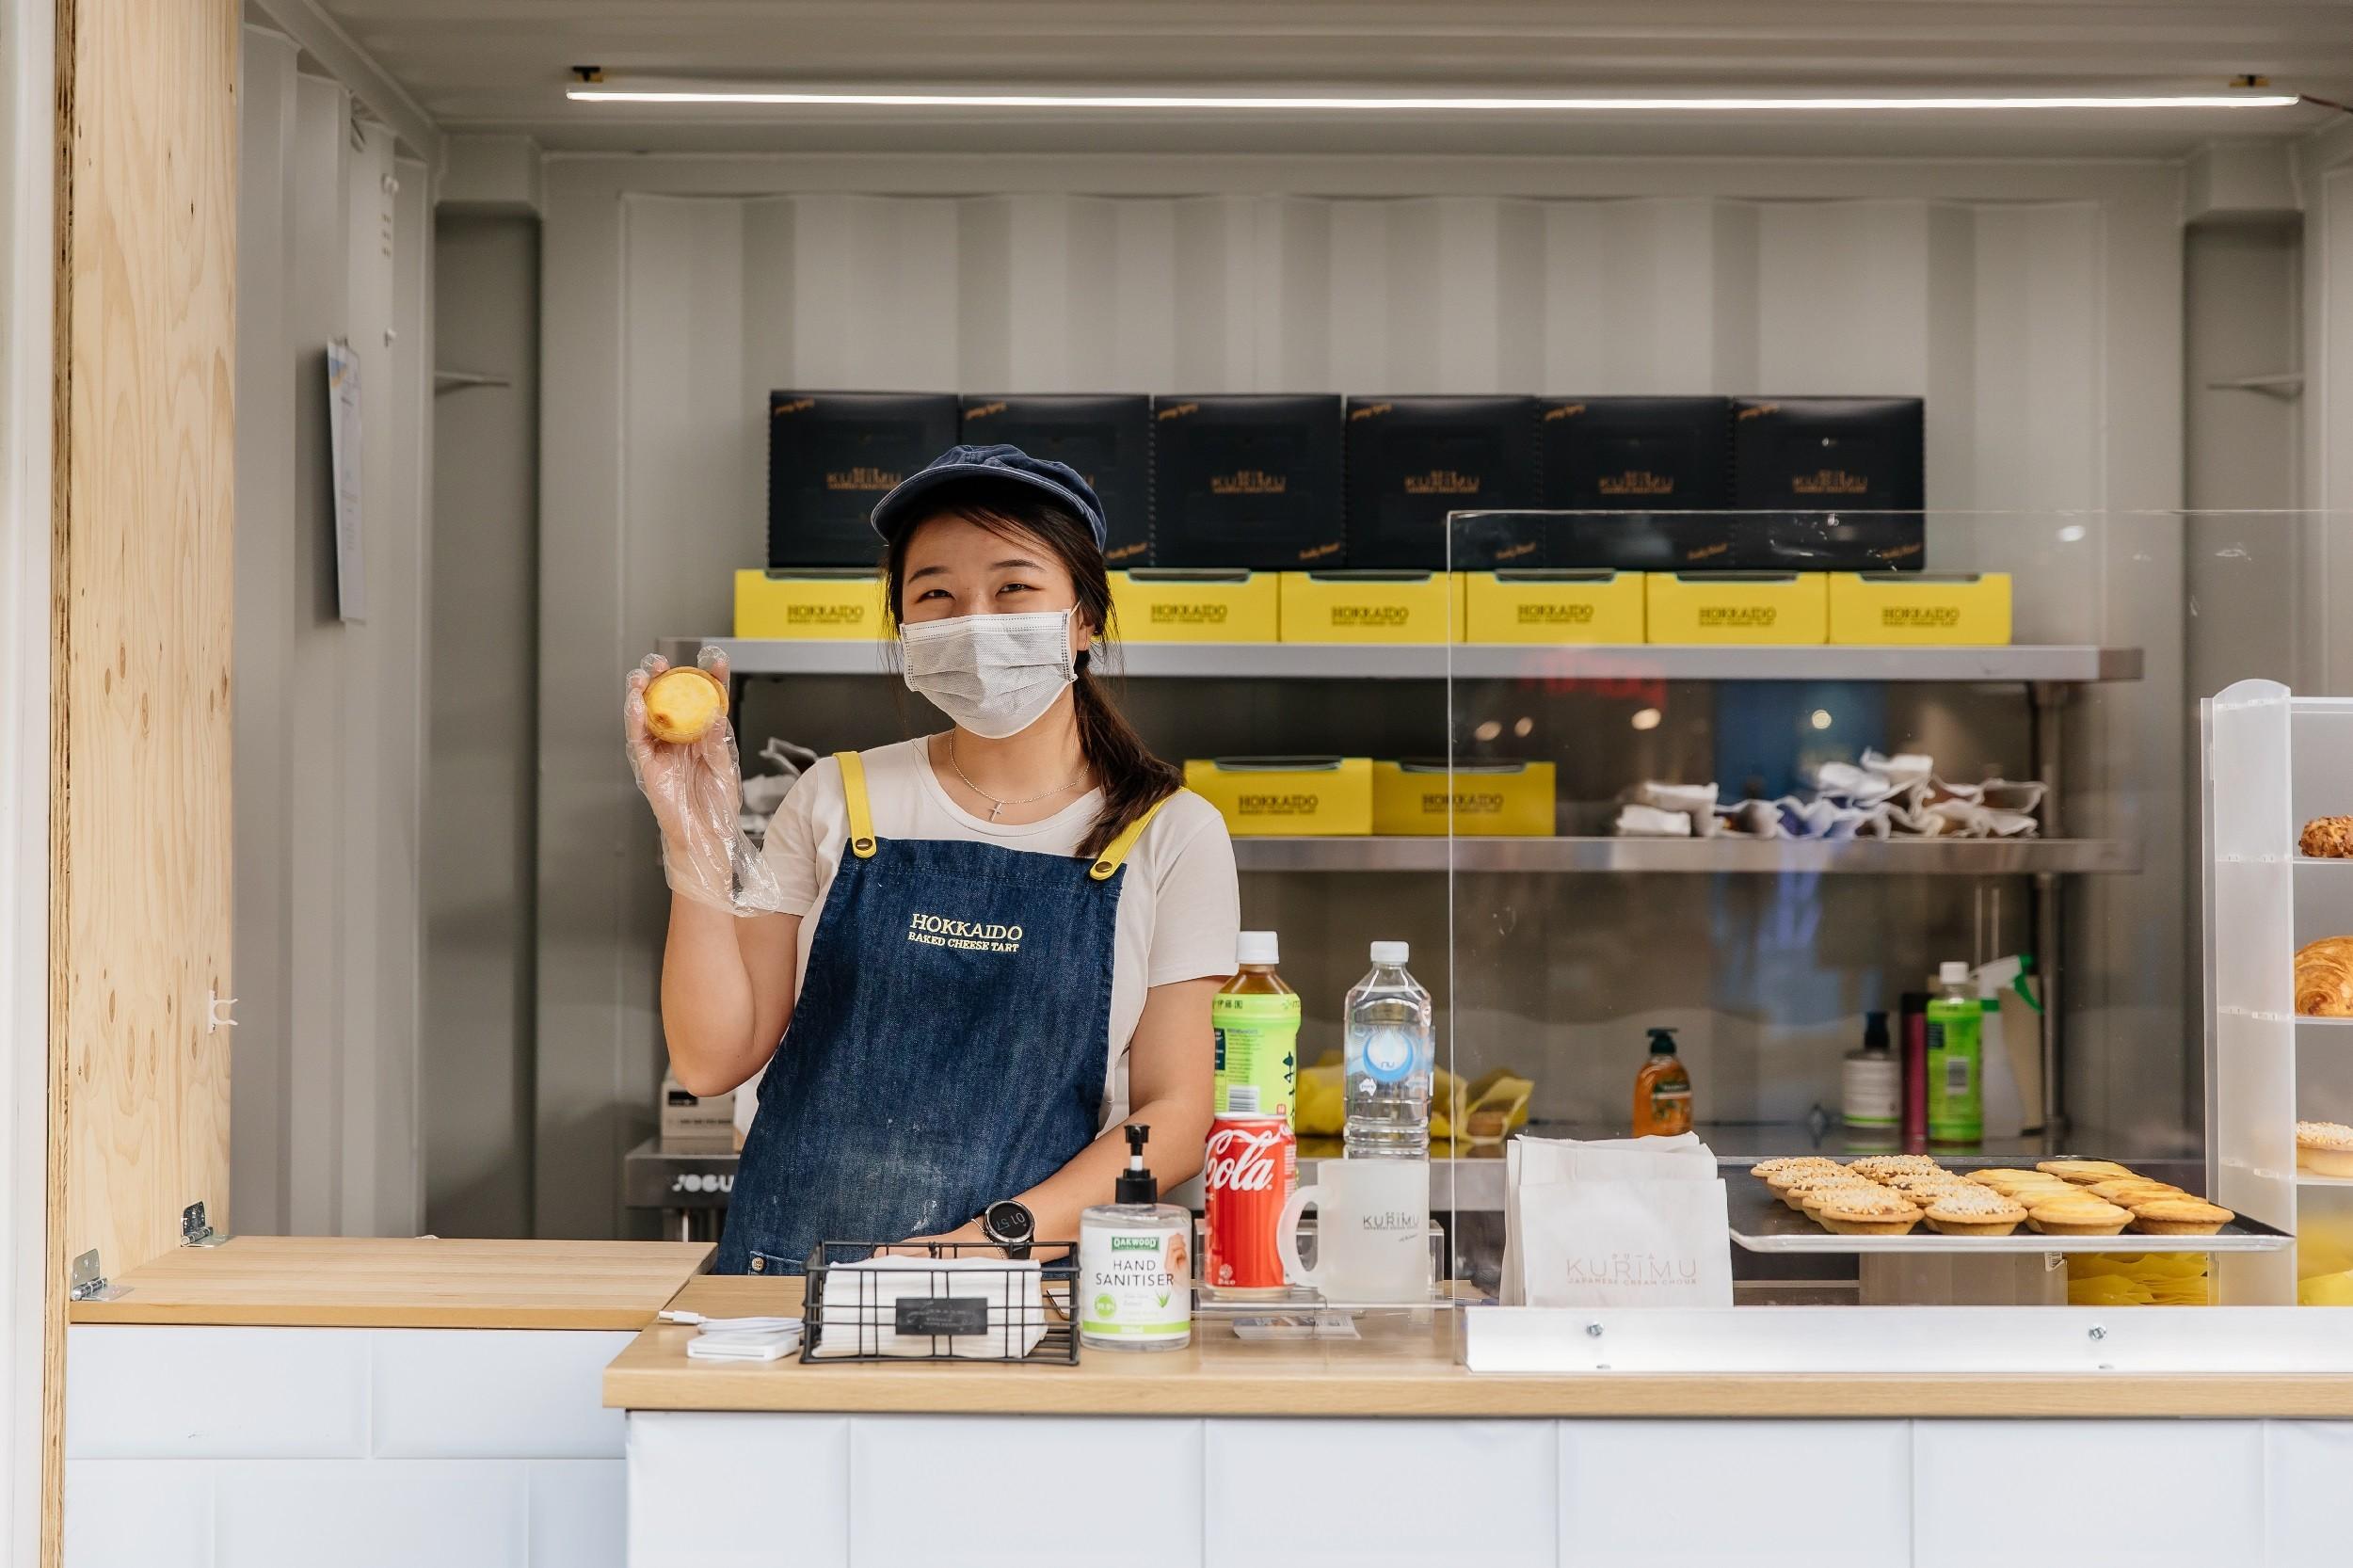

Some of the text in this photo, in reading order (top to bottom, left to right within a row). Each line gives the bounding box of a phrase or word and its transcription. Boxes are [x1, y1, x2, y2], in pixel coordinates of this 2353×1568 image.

[787, 604, 865, 618] HOKKAIDO
[1150, 604, 1228, 617] HOKKAIDO
[1331, 606, 1410, 620] HOKKAIDO
[1518, 604, 1594, 617] HOKKAIDO
[1699, 607, 1778, 620] HOKKAIDO
[1882, 606, 1960, 620] HOKKAIDO
[1238, 794, 1319, 808] HOKKAIDO
[1421, 793, 1504, 808] HOKKAIDO
[909, 913, 1023, 941] HOKKAIDO
[907, 931, 1019, 952] BAKED CHEESE TART
[1205, 1128, 1279, 1192] Cola
[1363, 1214, 1420, 1228] KURIMU
[1113, 1238, 1158, 1248] OAKWOOD
[1113, 1259, 1157, 1272] HAND
[1566, 1257, 1697, 1279] KURIMU
[1096, 1272, 1175, 1287] SANITISER
